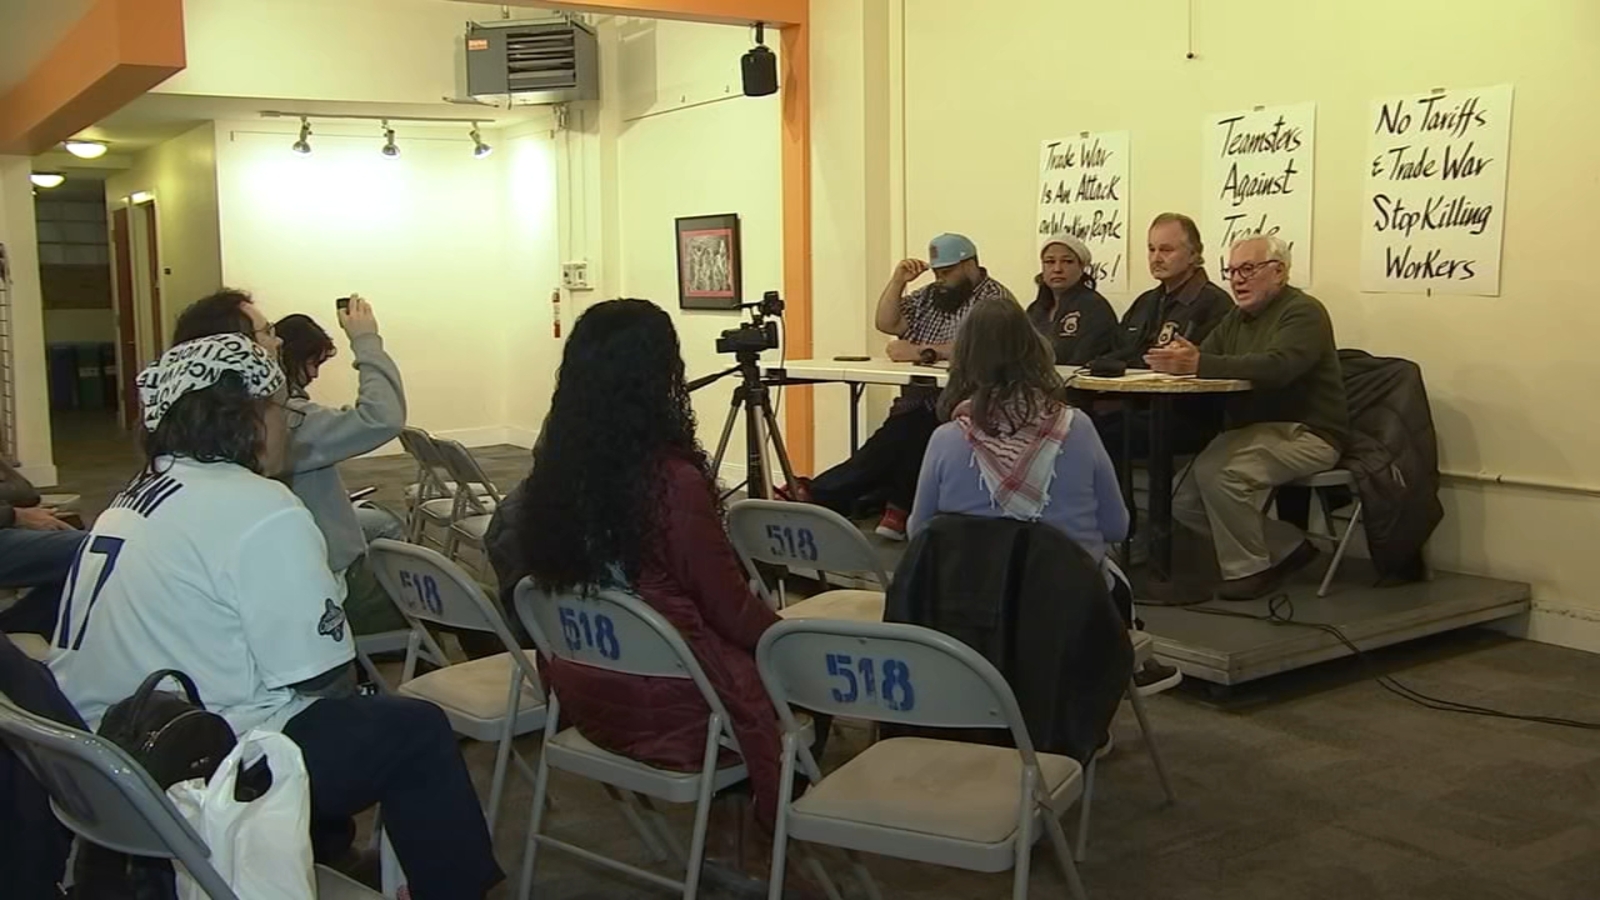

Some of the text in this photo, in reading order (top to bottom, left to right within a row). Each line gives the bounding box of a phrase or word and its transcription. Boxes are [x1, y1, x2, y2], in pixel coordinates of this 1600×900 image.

[1376, 95, 1487, 138] No Tariffs
[1045, 138, 1113, 171] Trade War
[1218, 116, 1302, 158] Teamsters
[1388, 145, 1439, 180] Trade
[1442, 141, 1494, 180] War
[1041, 173, 1121, 204] Is An Attack
[1220, 158, 1298, 206] Against
[1089, 210, 1122, 244] People
[1221, 214, 1280, 248] Trade
[1373, 193, 1493, 237] Stop Killing
[1386, 245, 1476, 280] Workers
[766, 525, 818, 561] 518
[57, 535, 126, 651] 17
[559, 607, 620, 660] 518
[826, 654, 915, 711] 518
